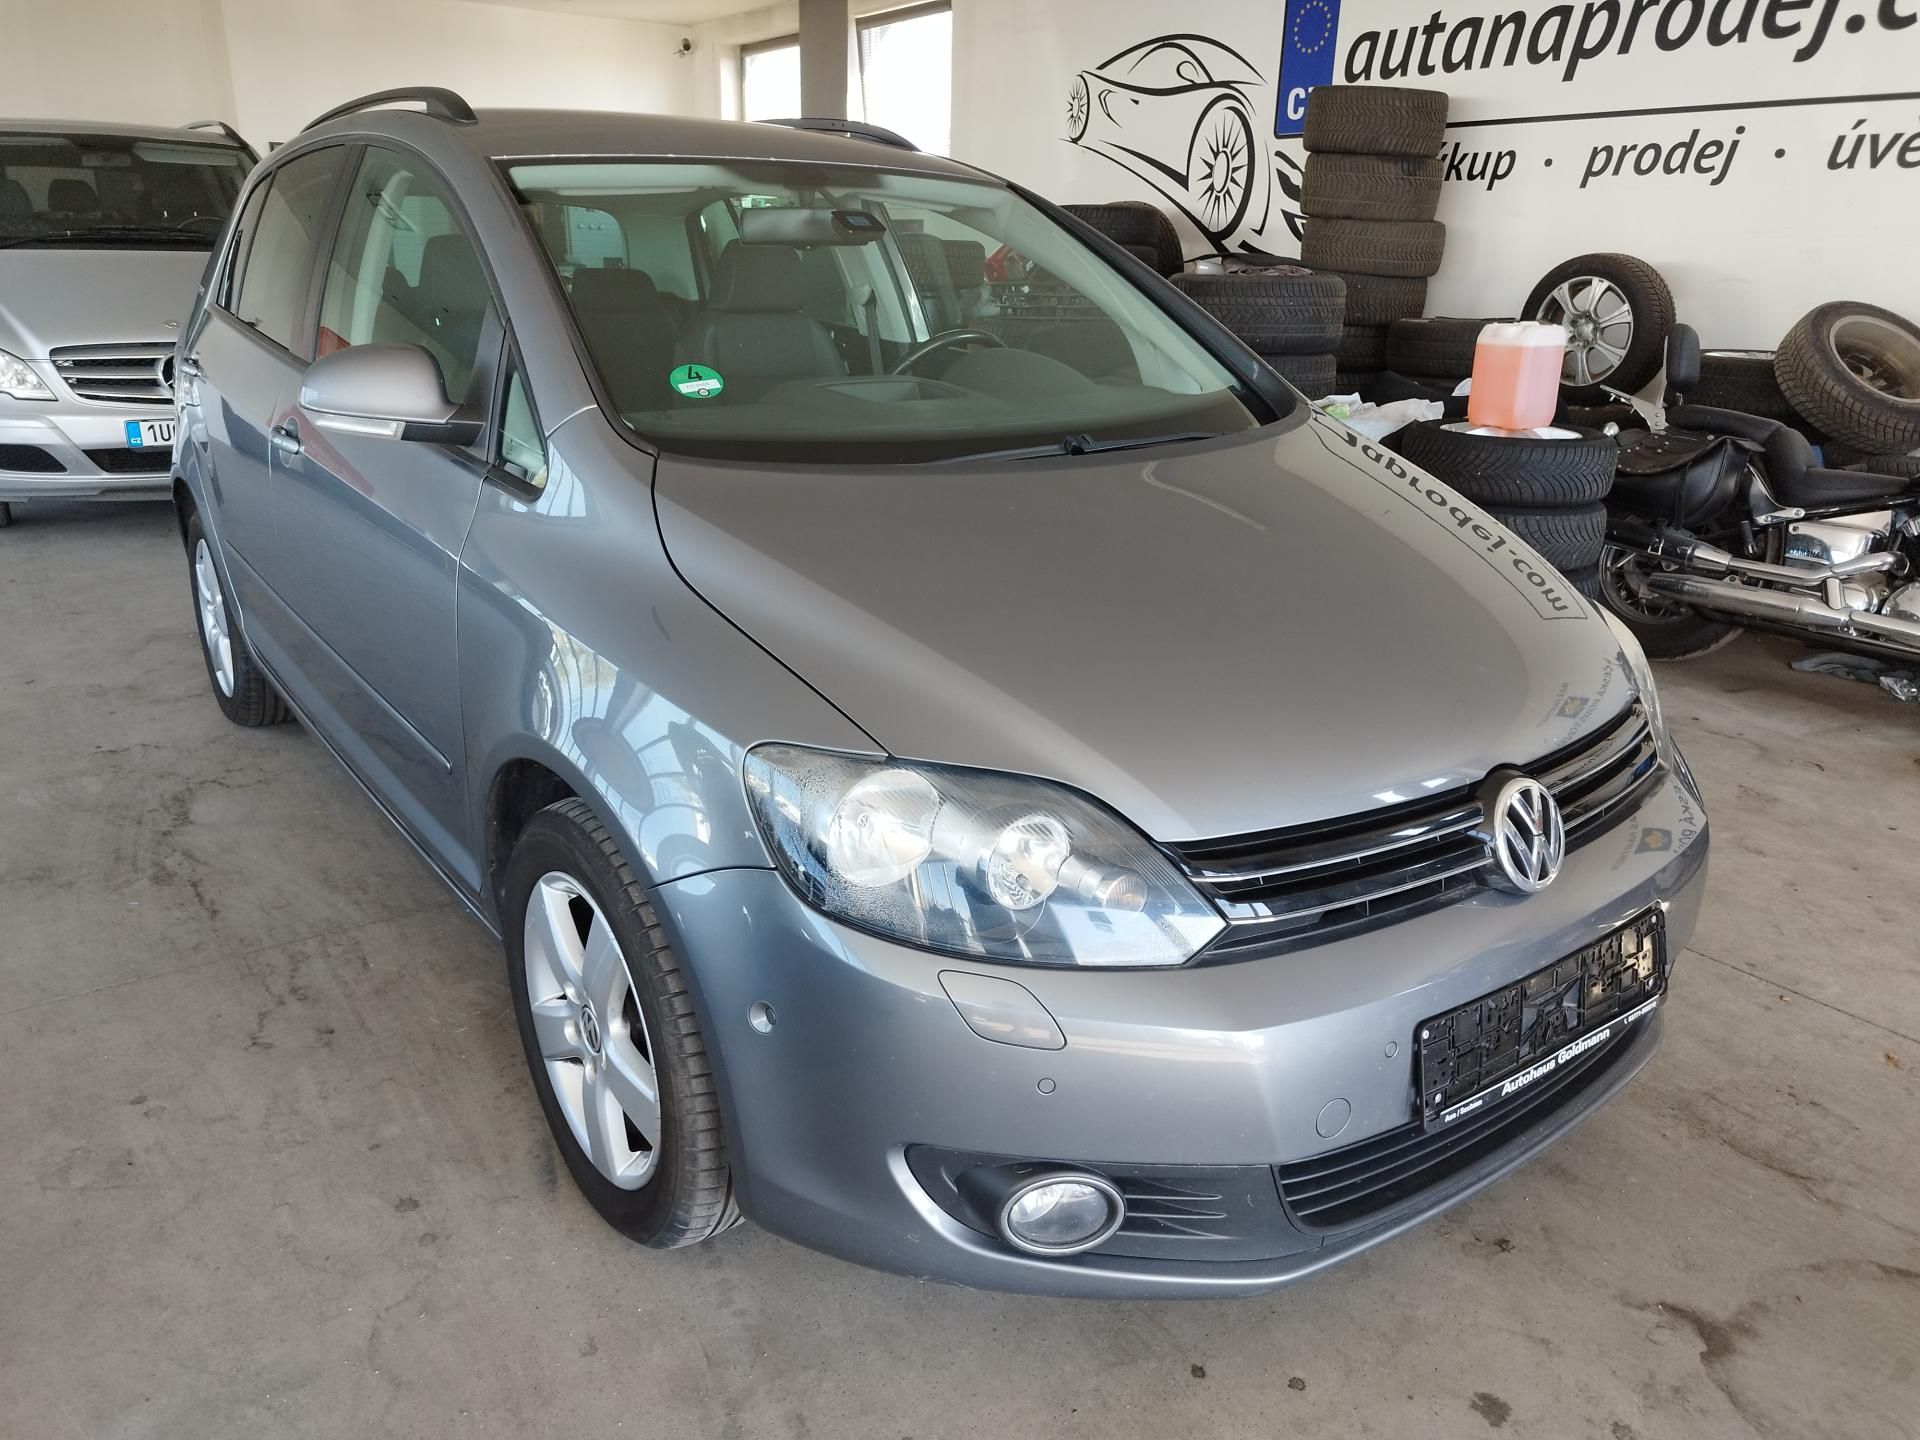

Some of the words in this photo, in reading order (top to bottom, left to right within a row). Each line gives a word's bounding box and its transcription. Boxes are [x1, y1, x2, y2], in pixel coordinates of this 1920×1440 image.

[1287, 86, 1313, 121] C
[1440, 141, 1517, 192] kup
[1579, 125, 1746, 189] prodej
[687, 365, 703, 381] 4
[147, 423, 175, 443] 1U
[1501, 1059, 1556, 1096] Autohaus
[1557, 1028, 1610, 1064] Goldmann
